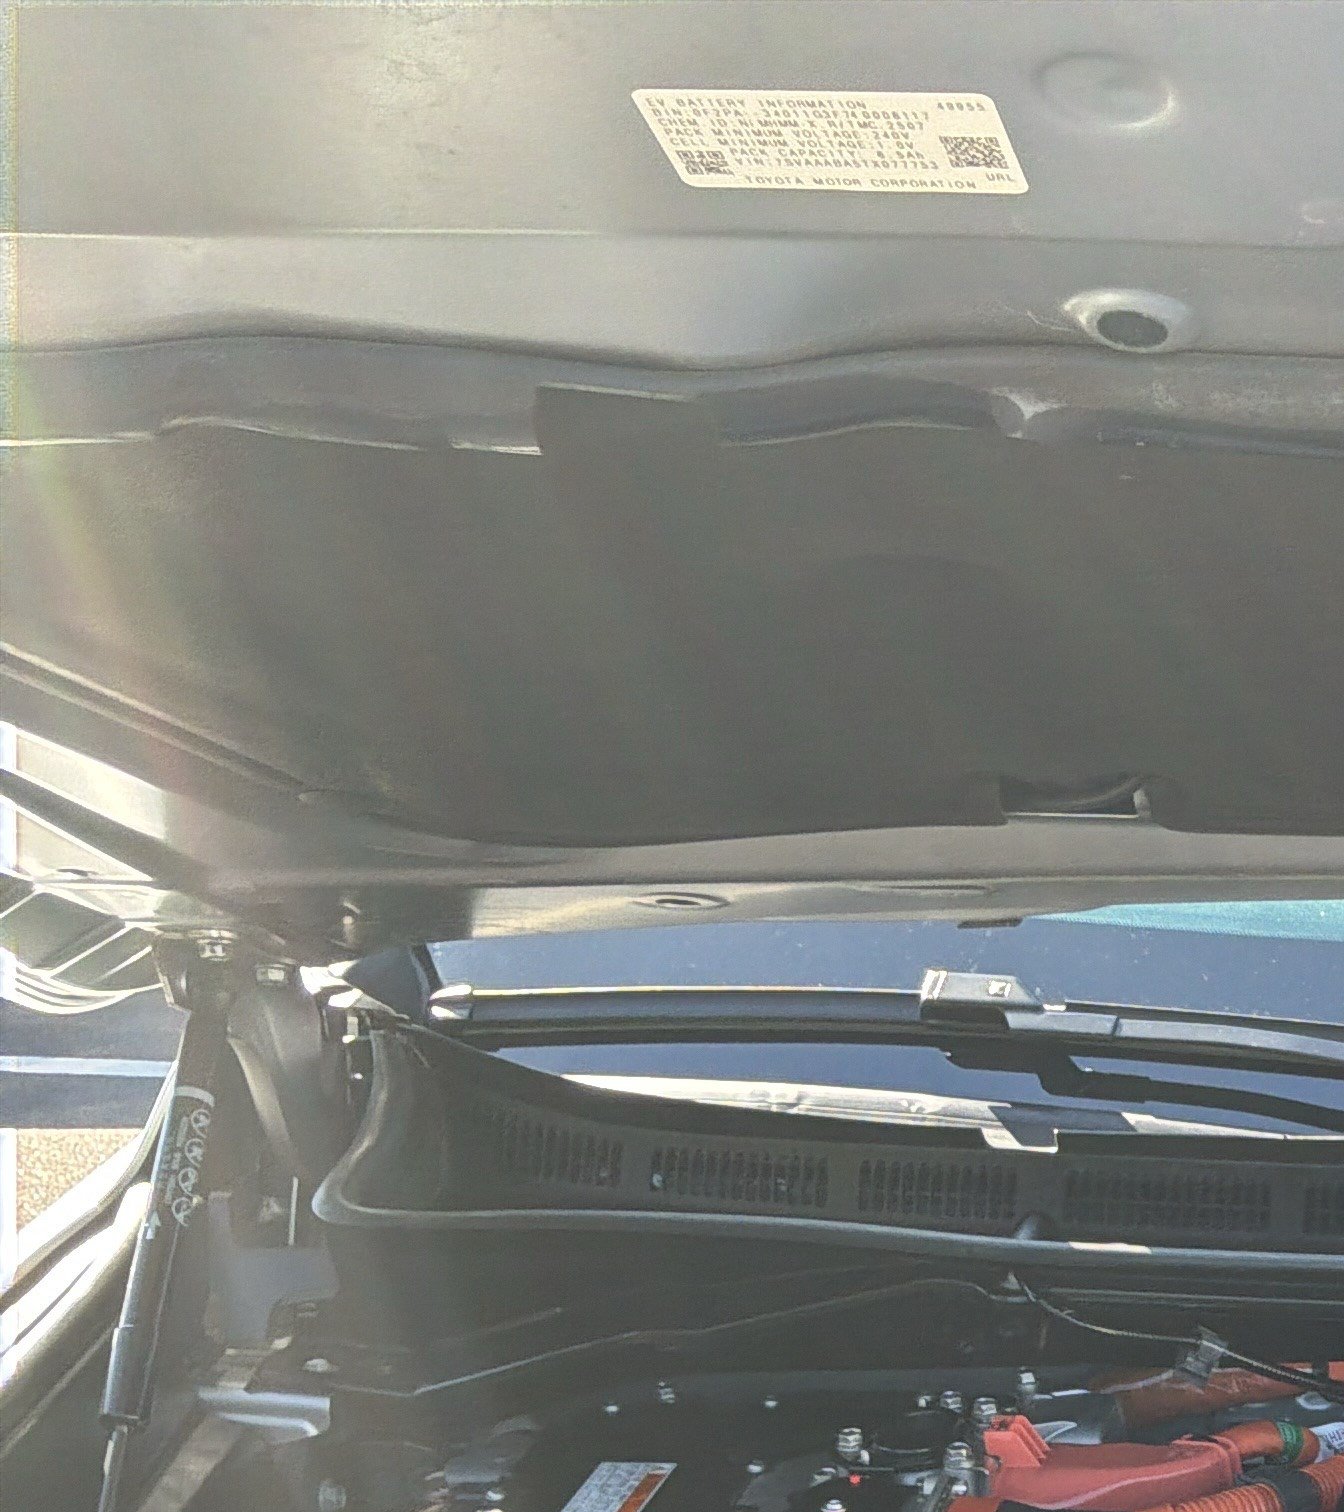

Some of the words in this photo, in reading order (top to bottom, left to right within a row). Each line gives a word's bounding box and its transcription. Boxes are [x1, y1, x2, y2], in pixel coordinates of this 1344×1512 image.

[643, 97, 667, 106] EV
[673, 97, 747, 107] BATTERY
[756, 98, 867, 109] INFORMATION
[662, 127, 705, 136] PACK
[710, 128, 784, 138] MINIMUM
[667, 137, 710, 146] CELL
[715, 137, 789, 147] MINIMUM
[727, 148, 770, 157] PACK
[743, 175, 806, 185] TOYOTA
[810, 176, 863, 186] MOTOR
[868, 177, 978, 189] CORPORATION
